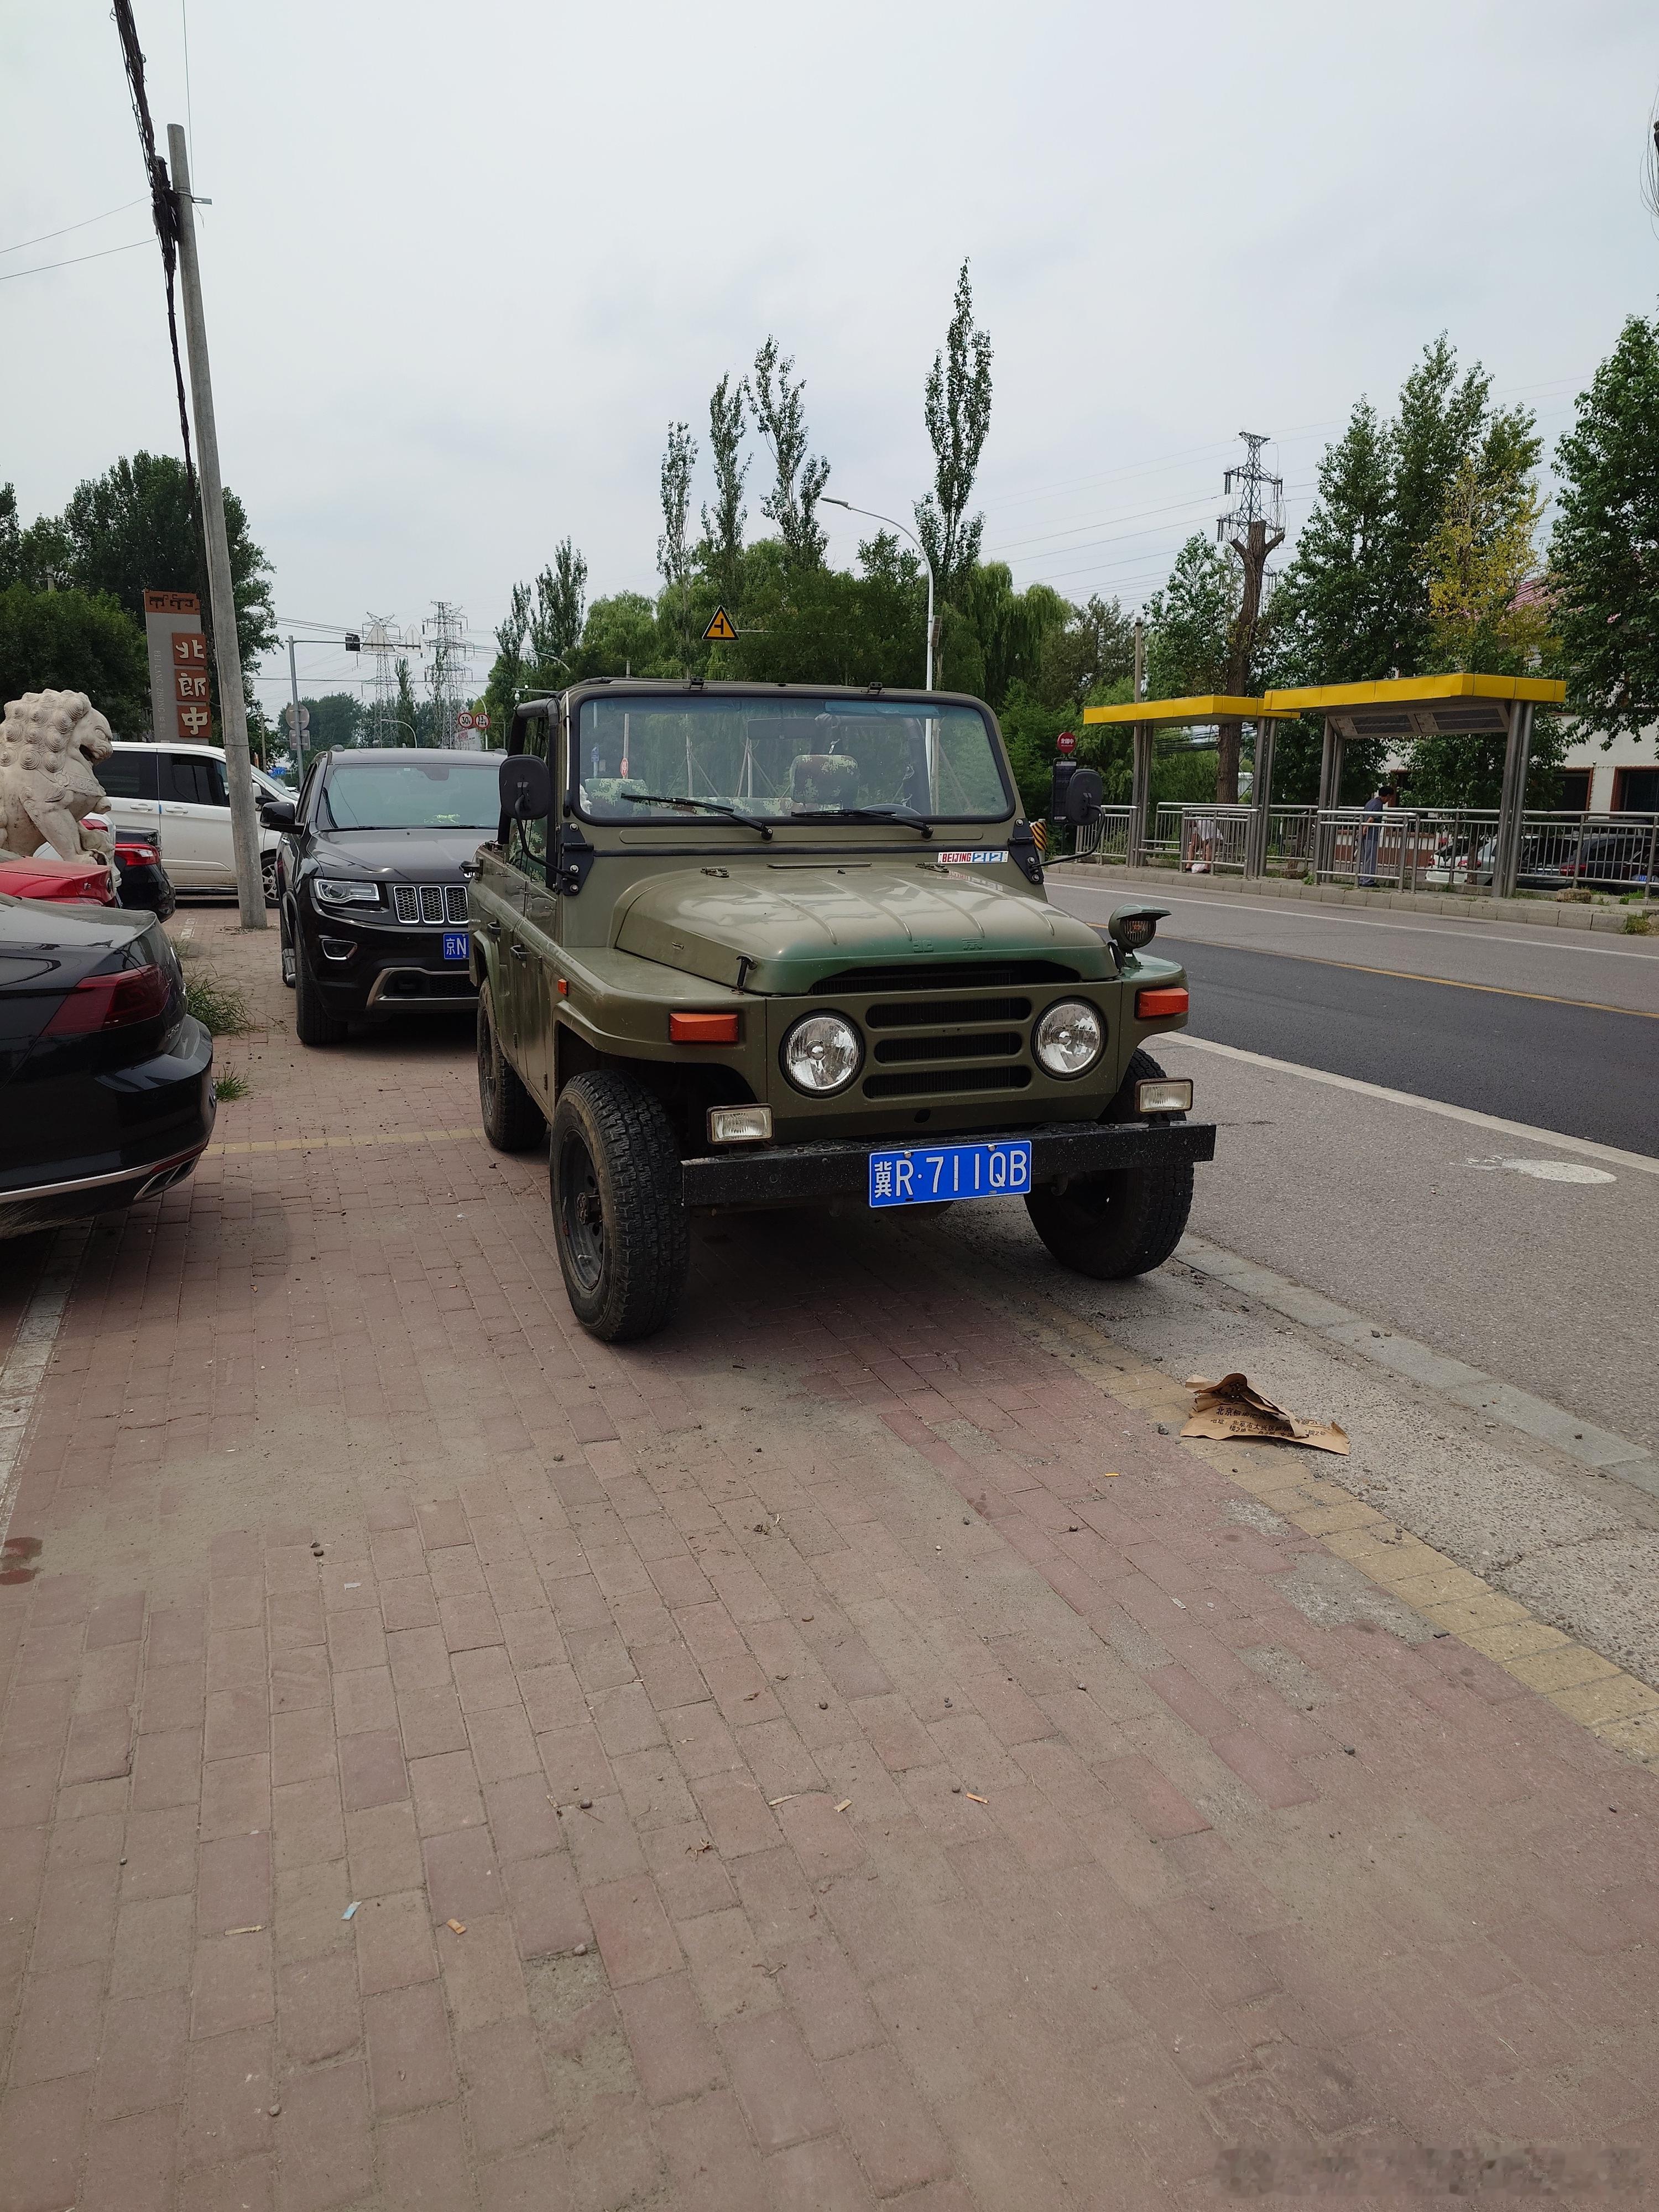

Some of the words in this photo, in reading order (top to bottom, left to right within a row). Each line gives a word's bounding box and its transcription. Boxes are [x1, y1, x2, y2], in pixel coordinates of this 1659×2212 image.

[155, 665, 163, 684] LANG
[176, 639, 208, 735] 北郎中
[156, 687, 165, 713] ZHONG
[942, 853, 972, 862] BEIJING
[973, 852, 1001, 862] 212
[446, 937, 466, 955] 京N
[874, 1150, 1027, 1198] 冀R·711QB
